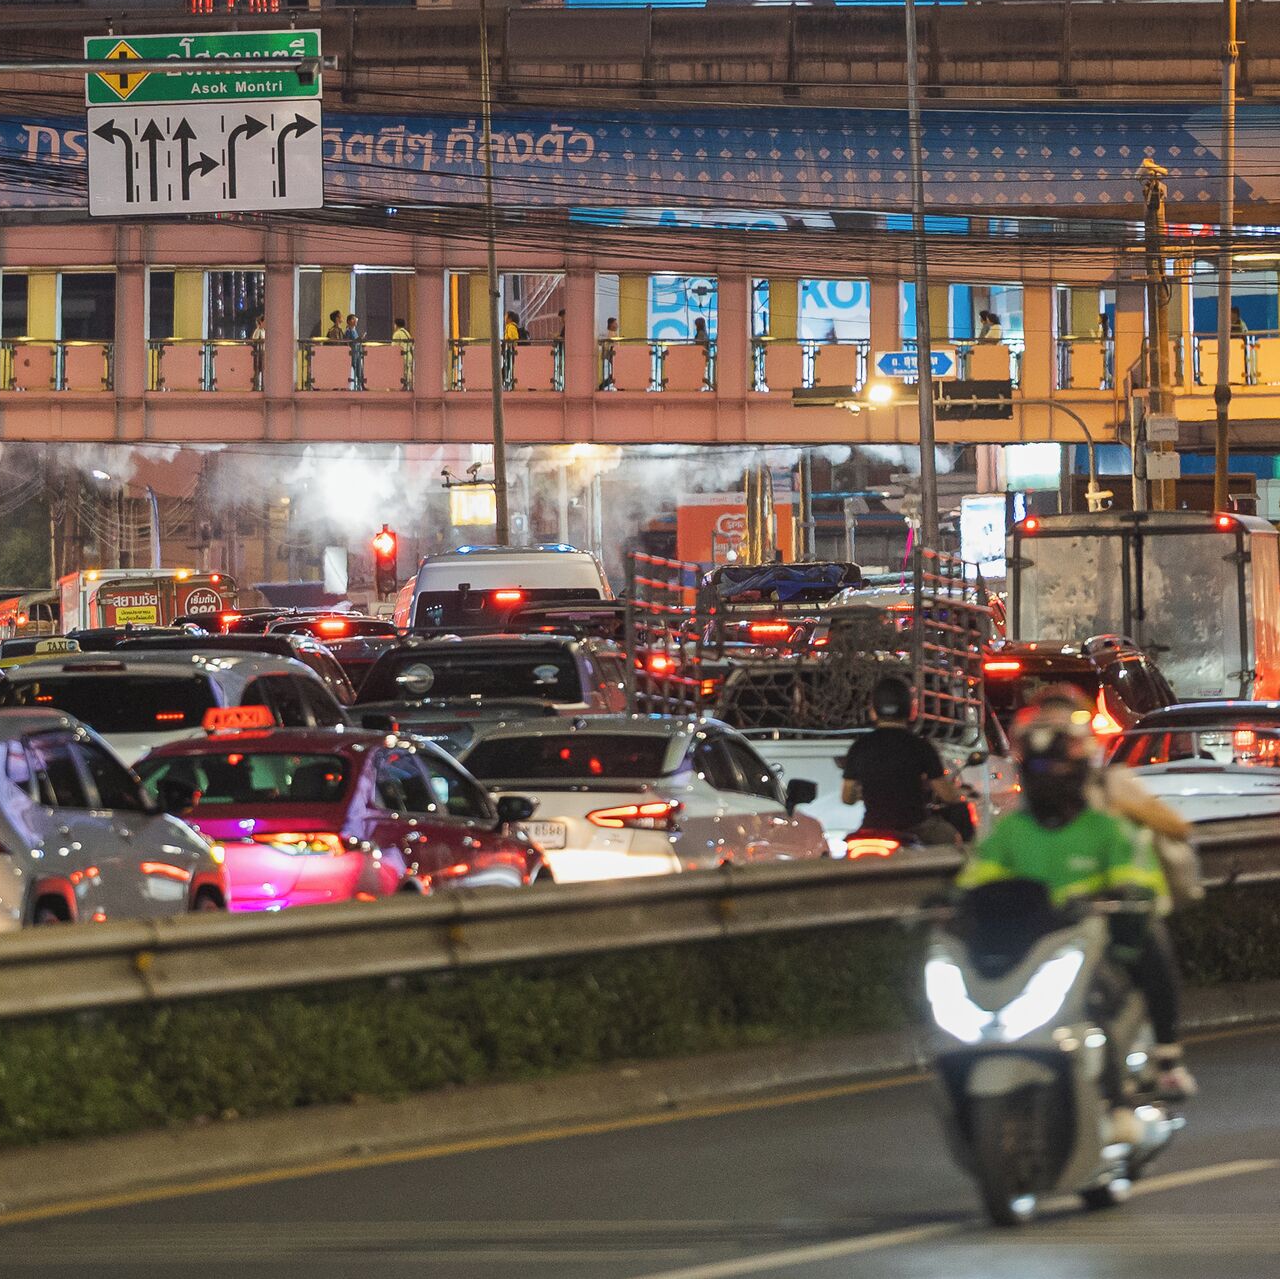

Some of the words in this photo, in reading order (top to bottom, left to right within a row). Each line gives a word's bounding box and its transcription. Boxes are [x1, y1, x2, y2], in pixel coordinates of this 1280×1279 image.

[190, 81, 228, 95] Asok
[235, 80, 284, 94] Montri
[322, 124, 434, 171] วิตดีๆ
[445, 119, 596, 165] ที่ลงตัว
[113, 592, 158, 607] สยามชัย
[47, 641, 67, 651] TAXI
